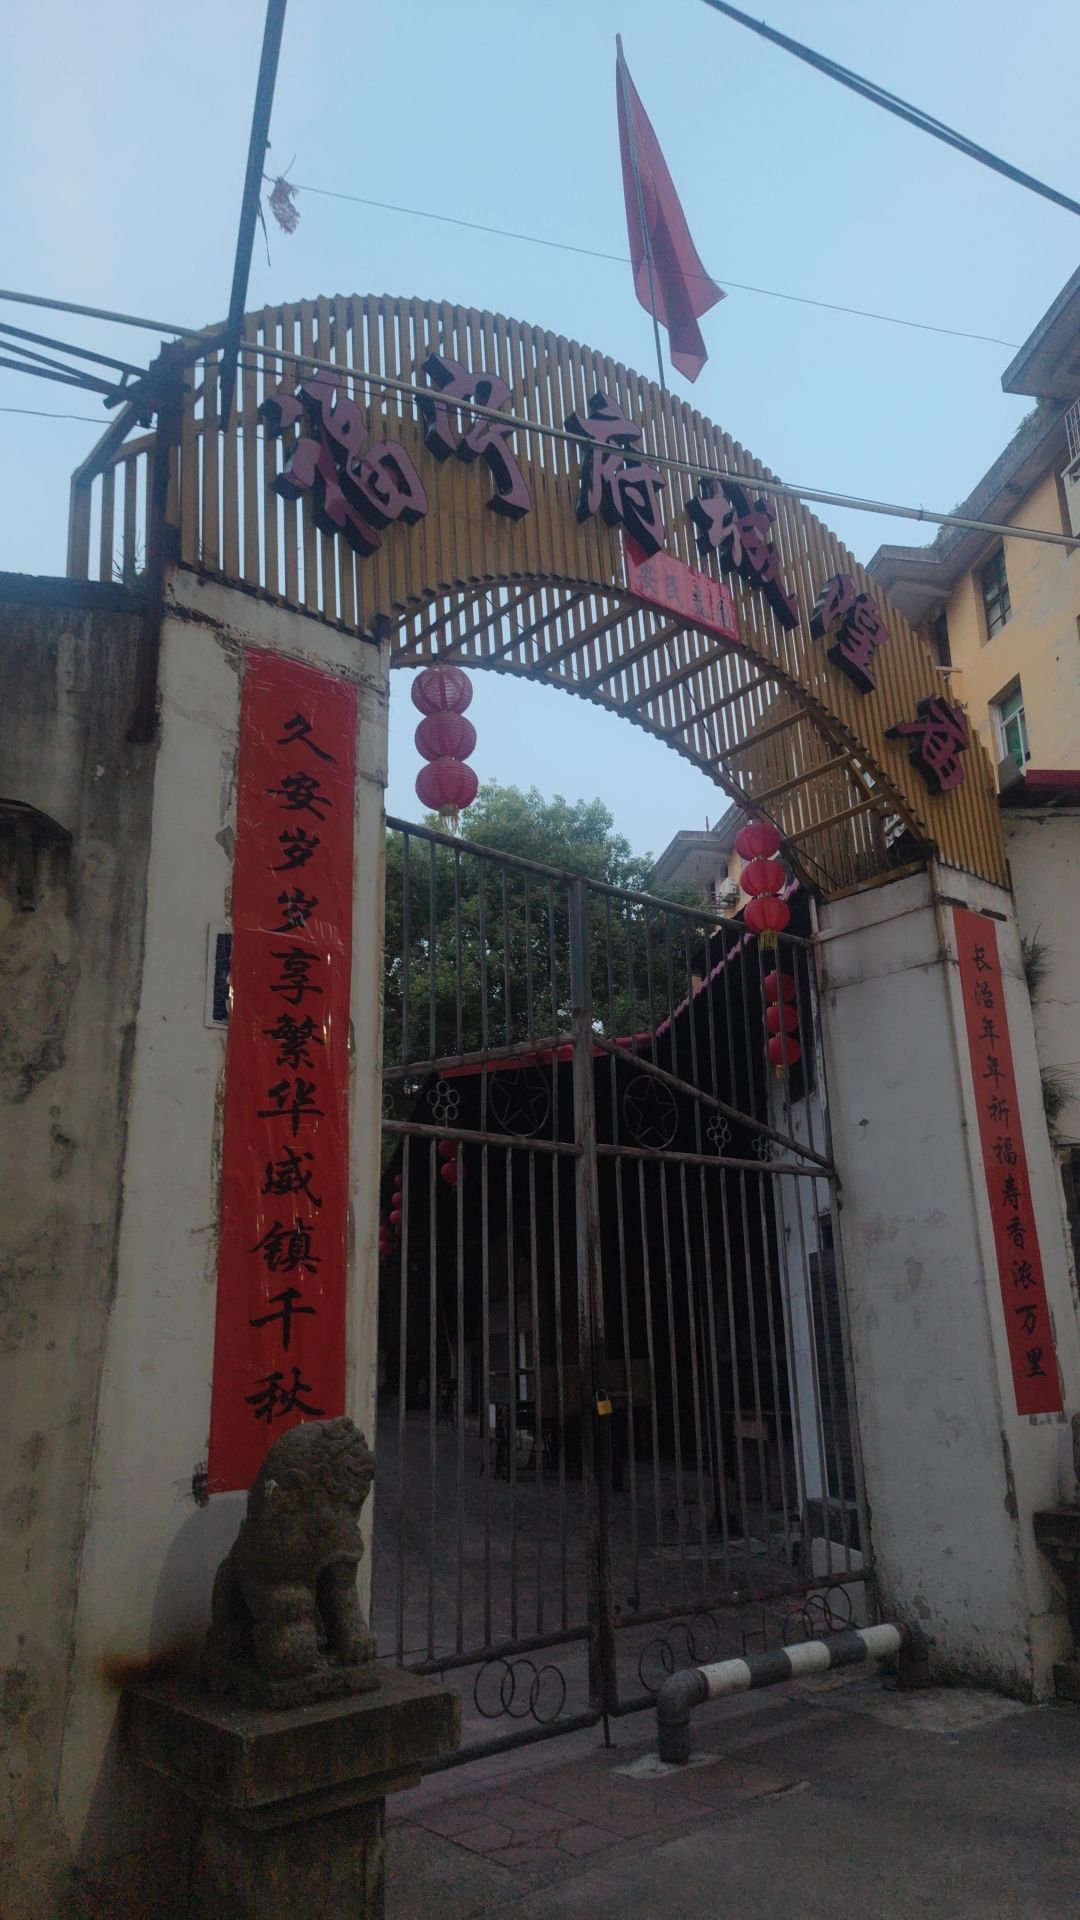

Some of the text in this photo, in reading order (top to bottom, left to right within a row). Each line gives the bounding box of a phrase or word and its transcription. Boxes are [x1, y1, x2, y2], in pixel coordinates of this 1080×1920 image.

[245, 711, 337, 1425] 久安岁岁享繁华威镇千秋
